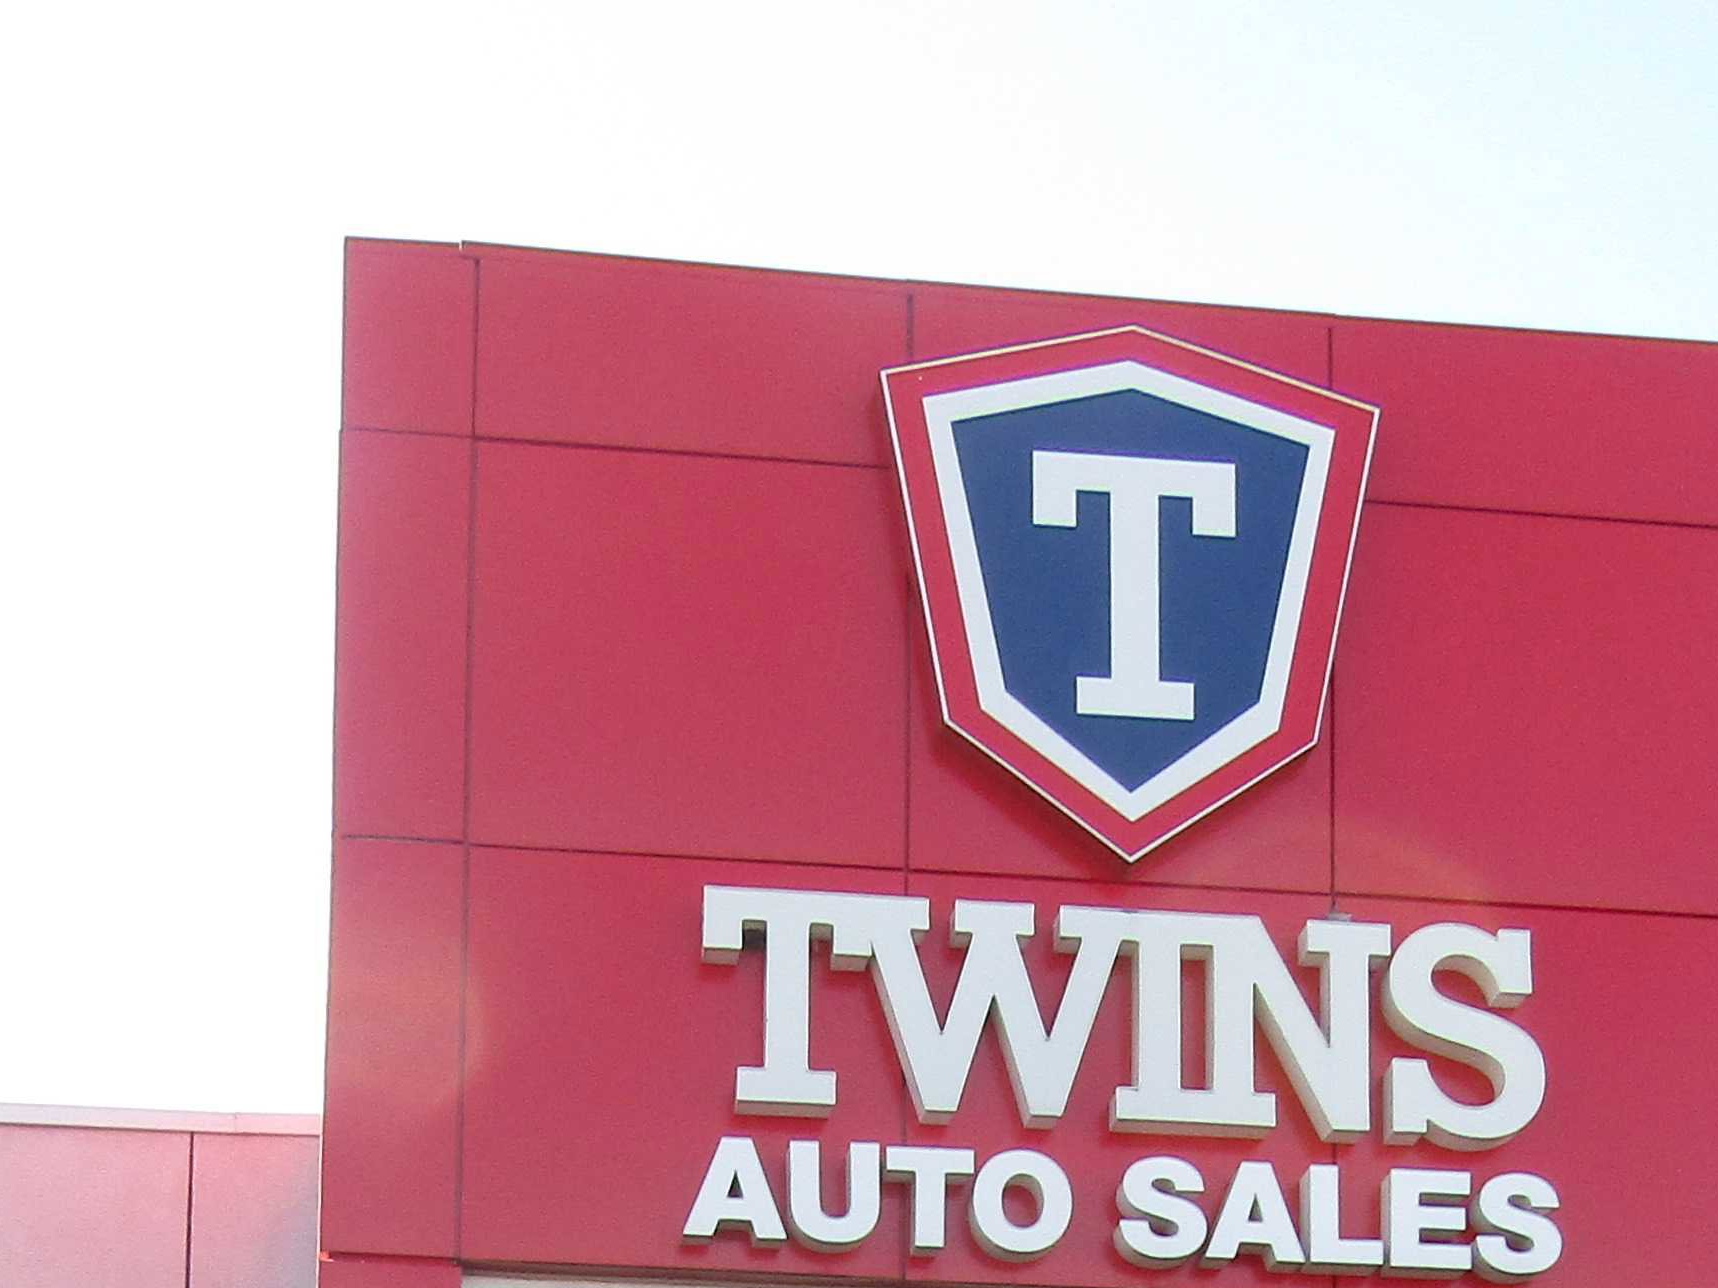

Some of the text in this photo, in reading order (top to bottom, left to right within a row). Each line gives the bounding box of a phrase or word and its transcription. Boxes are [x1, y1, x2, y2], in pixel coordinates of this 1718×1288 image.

[1032, 449, 1236, 721] T
[701, 884, 1547, 1152] TWINS
[683, 1136, 1564, 1284] AUTO SALES
